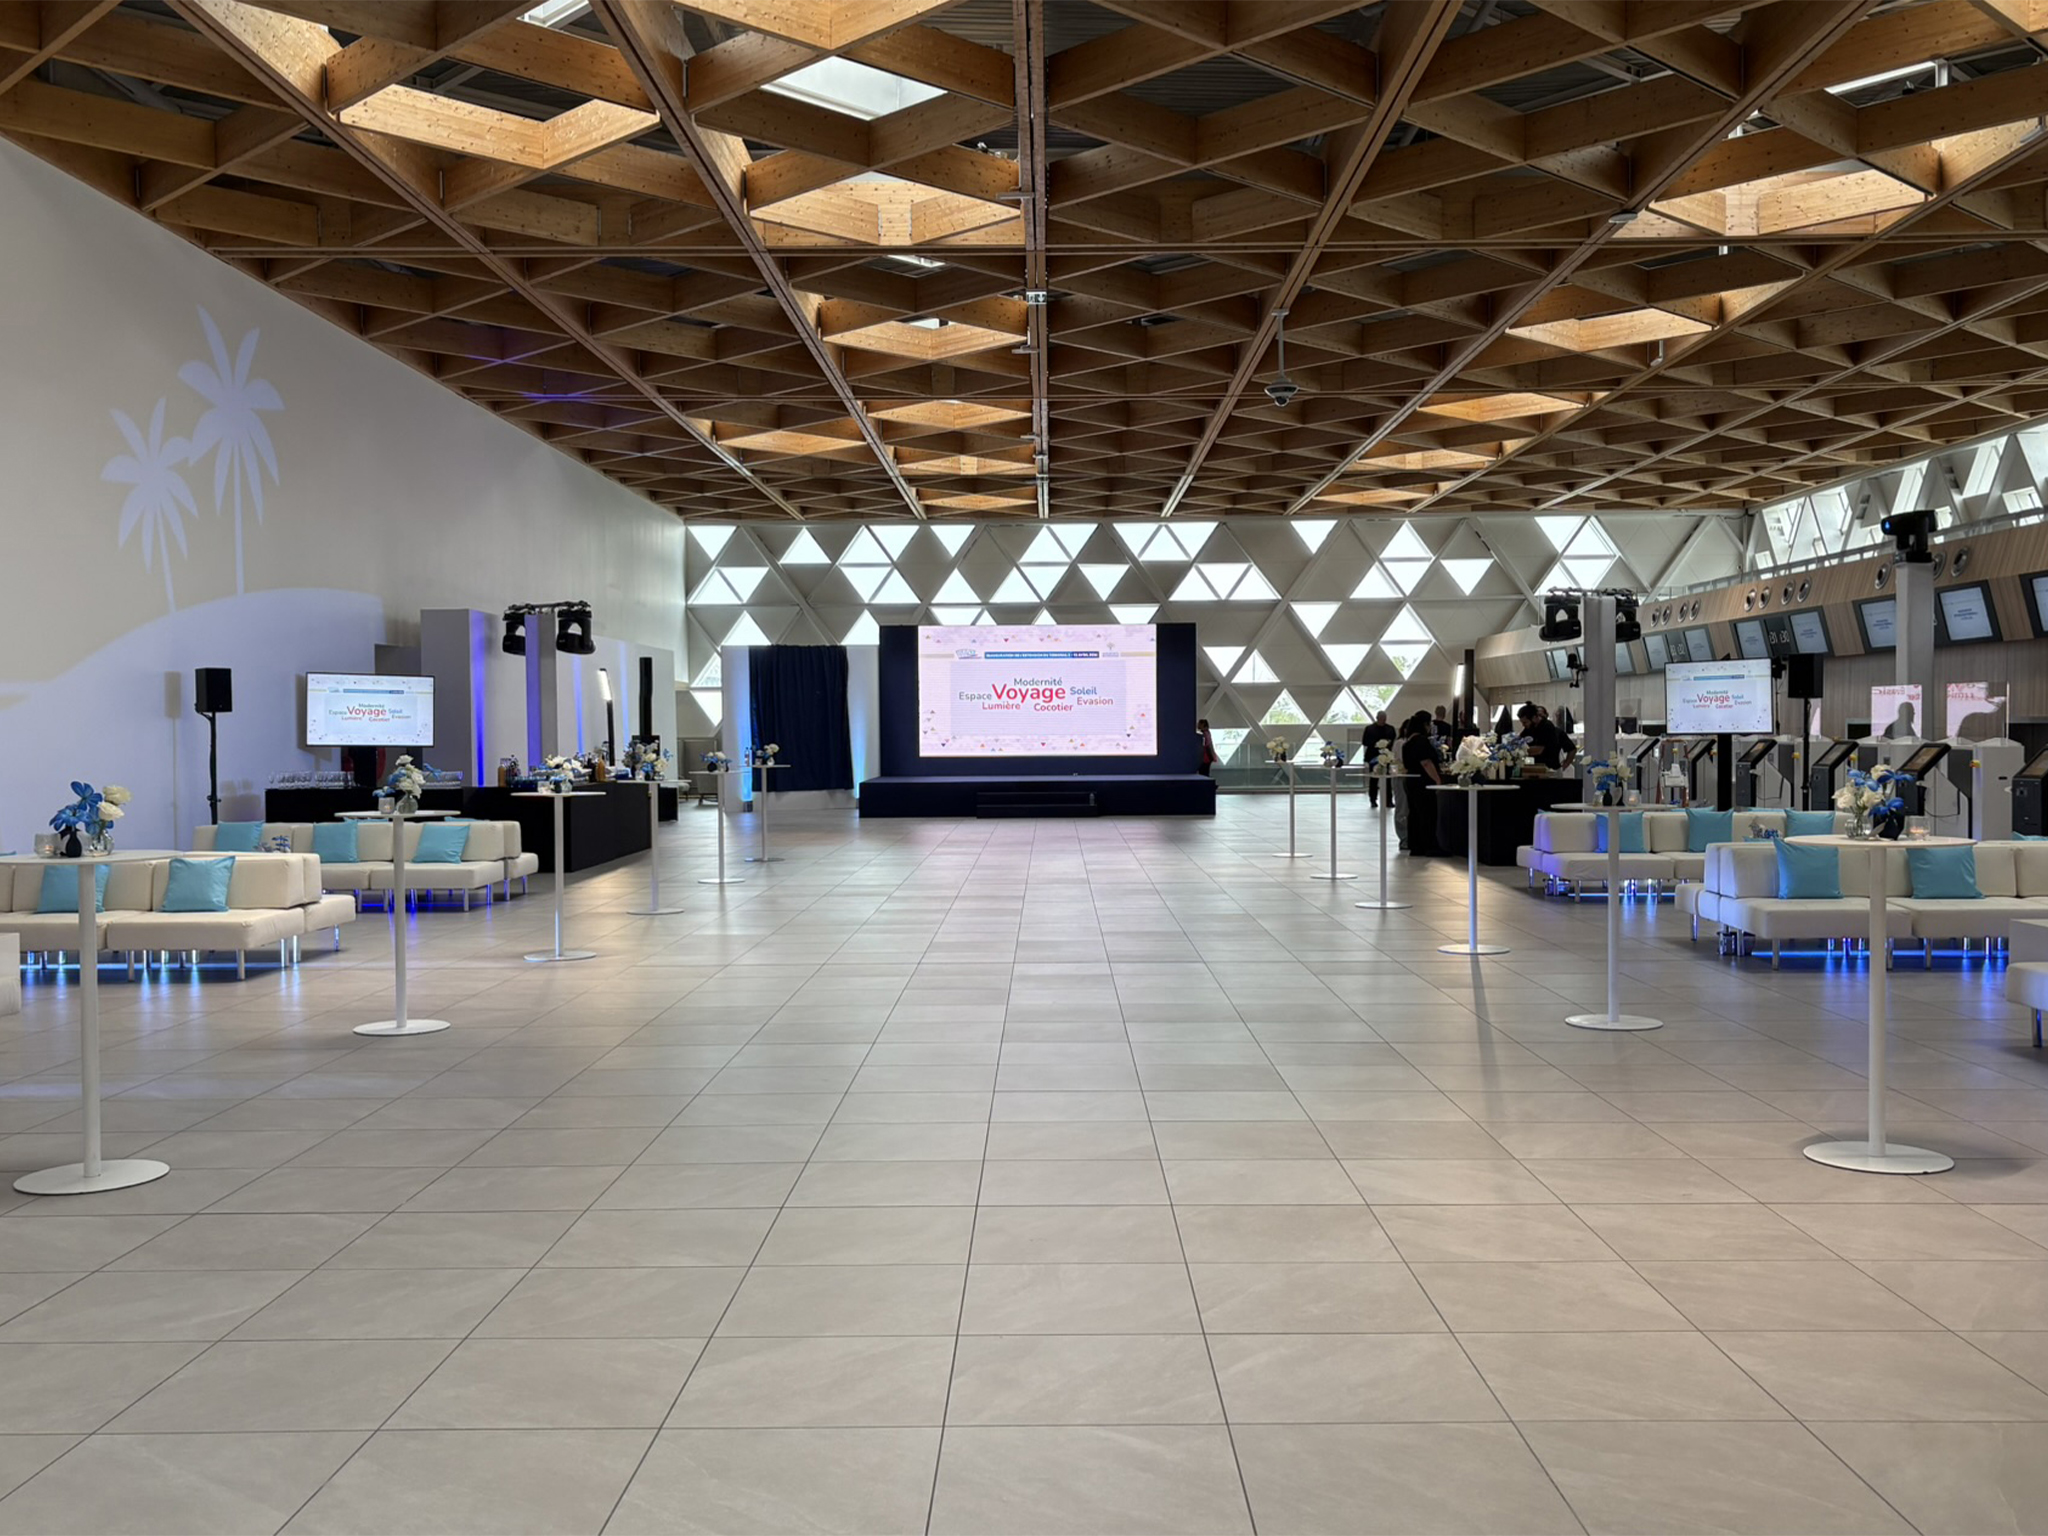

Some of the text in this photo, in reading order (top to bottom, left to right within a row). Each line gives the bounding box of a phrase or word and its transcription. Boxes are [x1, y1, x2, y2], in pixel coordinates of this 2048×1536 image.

[1014, 677, 1062, 686] Modernité
[992, 683, 1066, 703] Voyage
[1070, 686, 1097, 695] Soleil
[959, 692, 992, 702] Espace
[1077, 697, 1113, 705] Evasion
[1696, 693, 1730, 704] Voyage
[982, 701, 1020, 710] Lumière
[1034, 703, 1073, 711] Cocotier
[346, 706, 387, 717] Voyage
